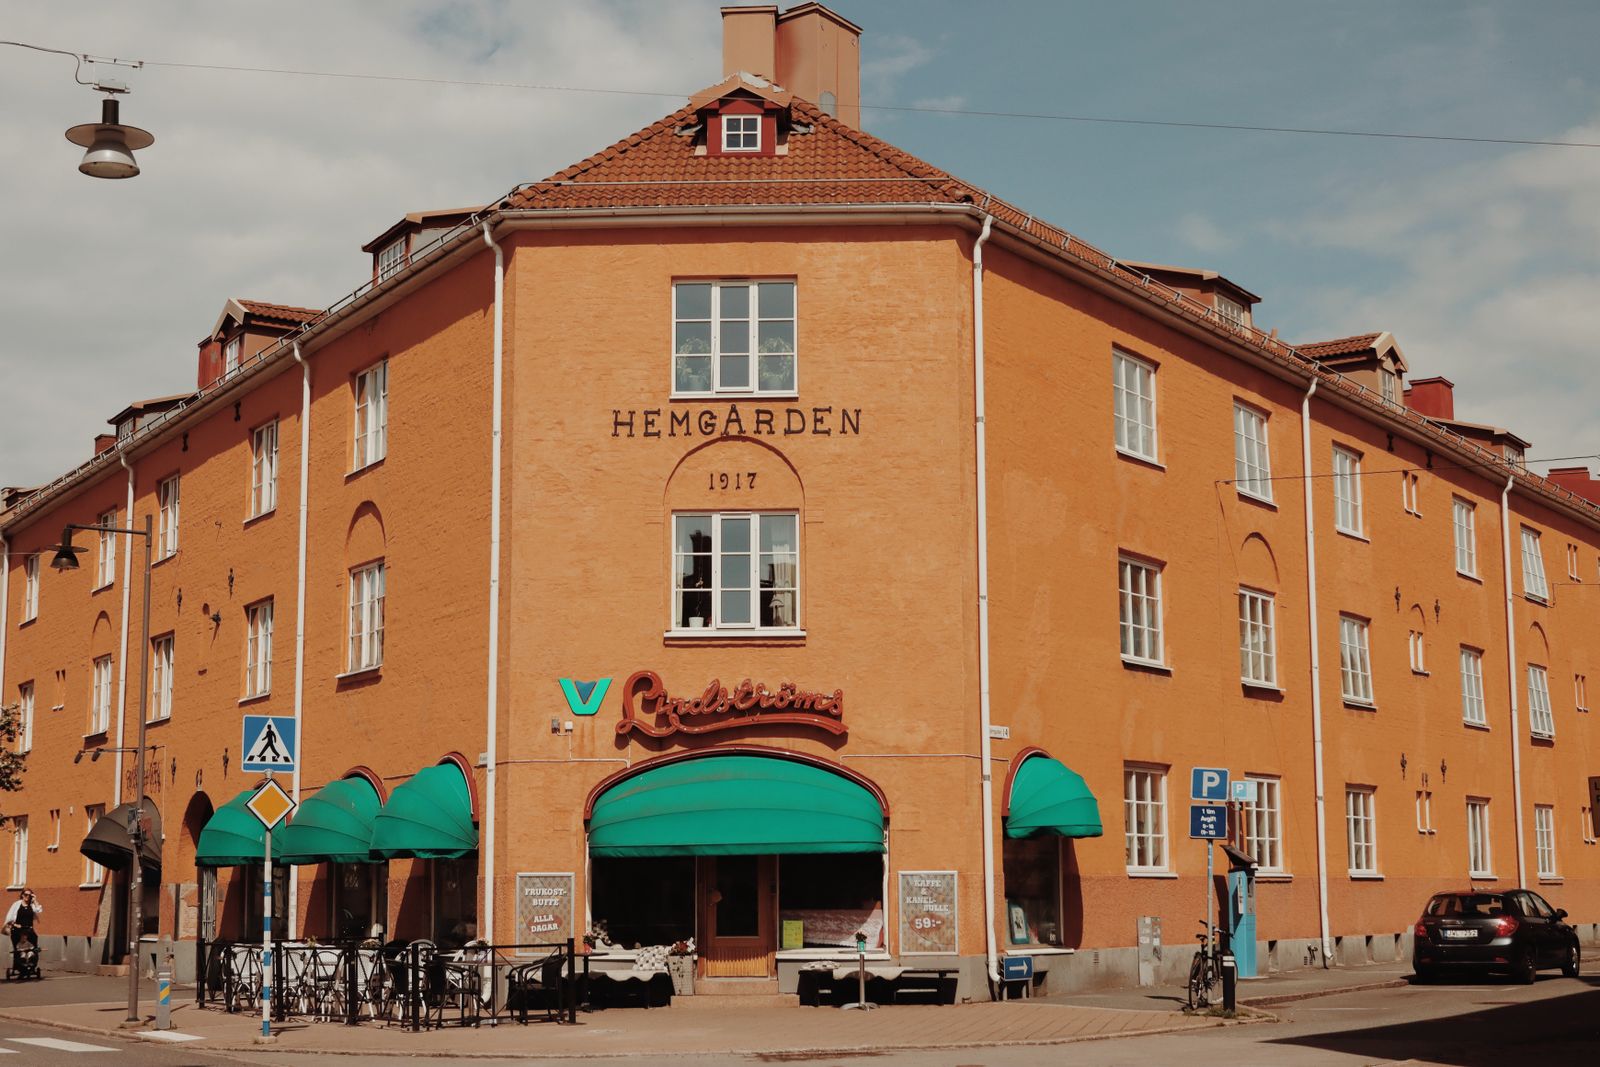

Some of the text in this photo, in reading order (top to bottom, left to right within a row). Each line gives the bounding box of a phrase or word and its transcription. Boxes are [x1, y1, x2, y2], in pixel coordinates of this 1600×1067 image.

[611, 404, 862, 438] HEMGÅRDEN
[708, 472, 757, 490] 1917
[615, 670, 849, 738] Lindströms
[1202, 771, 1220, 797] P
[1236, 783, 1244, 794] P
[525, 888, 567, 896] FRUKOST-
[923, 904, 949, 912] BULLE
[534, 914, 554, 922] ALLA
[532, 923, 558, 931] DAGAR
